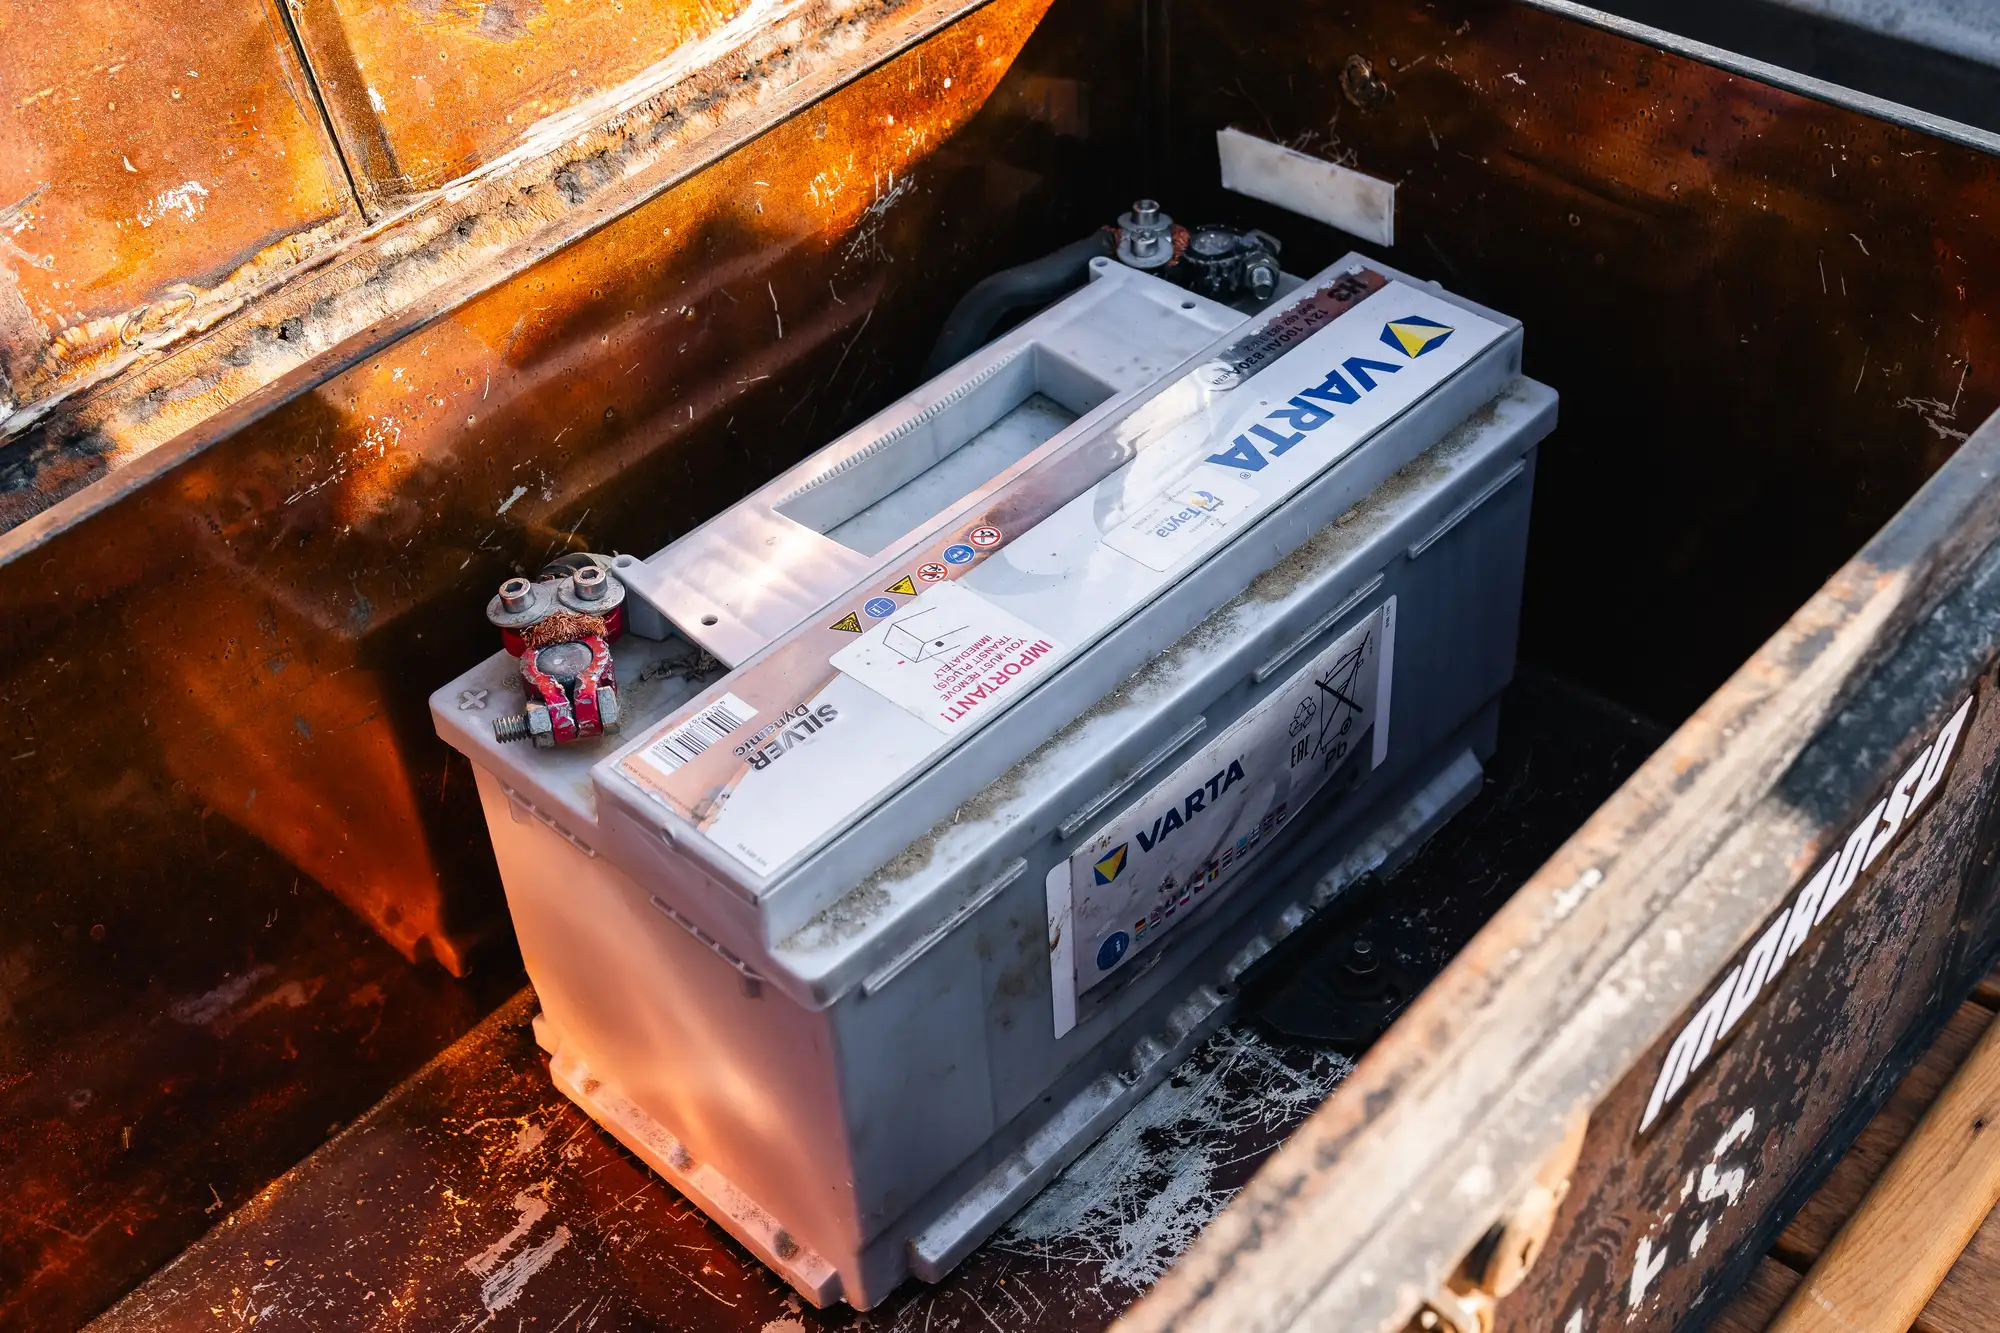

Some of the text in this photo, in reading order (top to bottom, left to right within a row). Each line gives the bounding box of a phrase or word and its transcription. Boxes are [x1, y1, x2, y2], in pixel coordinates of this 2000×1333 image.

[1303, 309, 1328, 325] 12V
[1327, 279, 1367, 301] H3
[1156, 507, 1201, 537] Tayna
[933, 635, 1011, 690] TRANSIT PLUG(S)
[934, 635, 991, 678] IMMEDIATELY
[940, 638, 1026, 701] YOU MUST REMOVE
[941, 640, 1052, 722] IMPORTANT!
[732, 701, 809, 757] Dynamic
[744, 703, 839, 770] SILVER
[1324, 741, 1348, 772] Pb
[1135, 758, 1246, 853] VARTA
